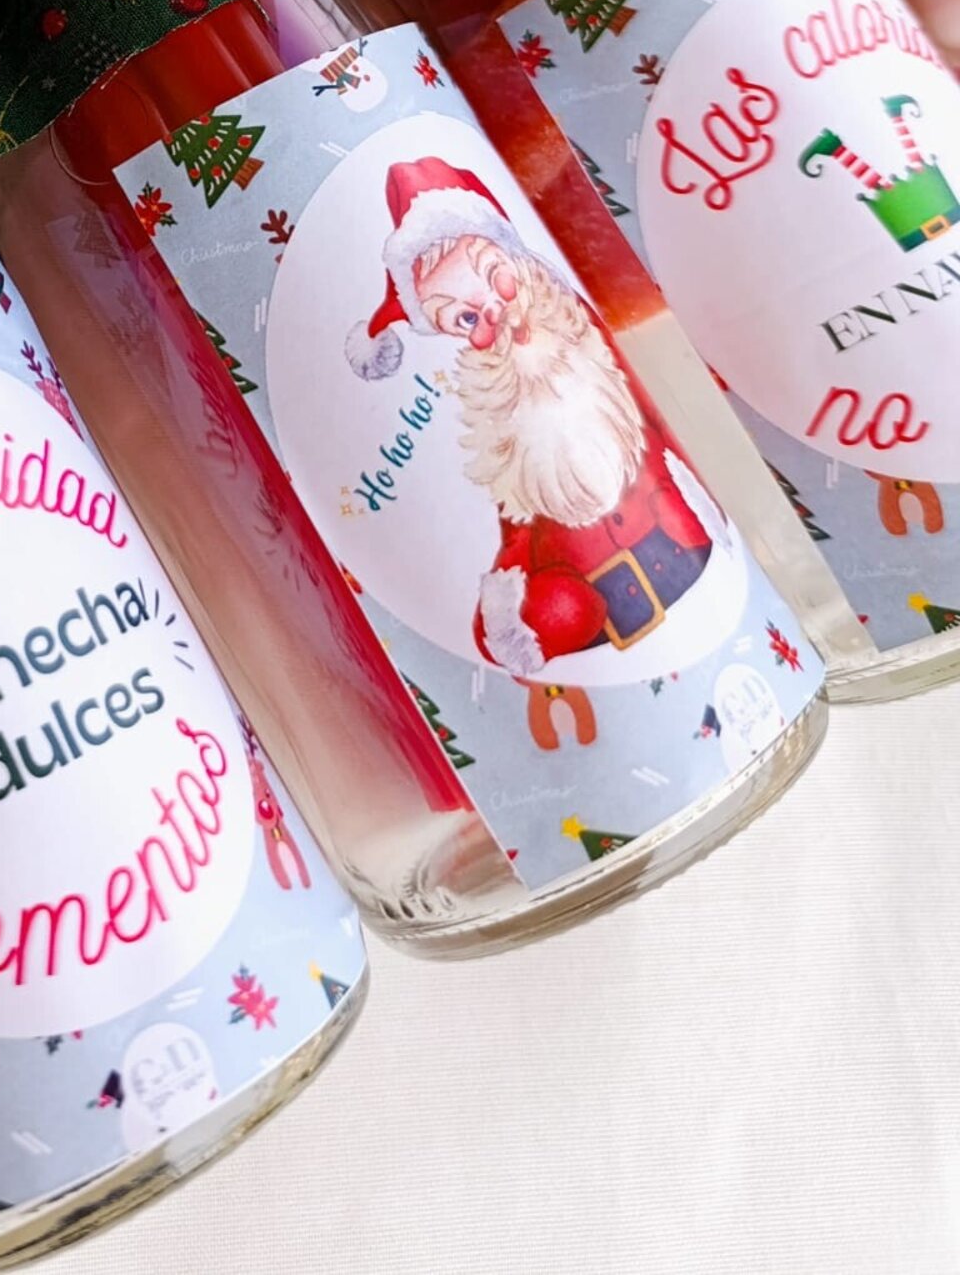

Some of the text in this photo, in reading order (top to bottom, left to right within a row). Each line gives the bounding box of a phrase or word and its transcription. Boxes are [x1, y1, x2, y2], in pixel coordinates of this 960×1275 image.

[654, 66, 781, 213] Las
[819, 252, 960, 354] EN NA
[353, 373, 441, 512] Ho ho ho!
[804, 385, 930, 452] no
